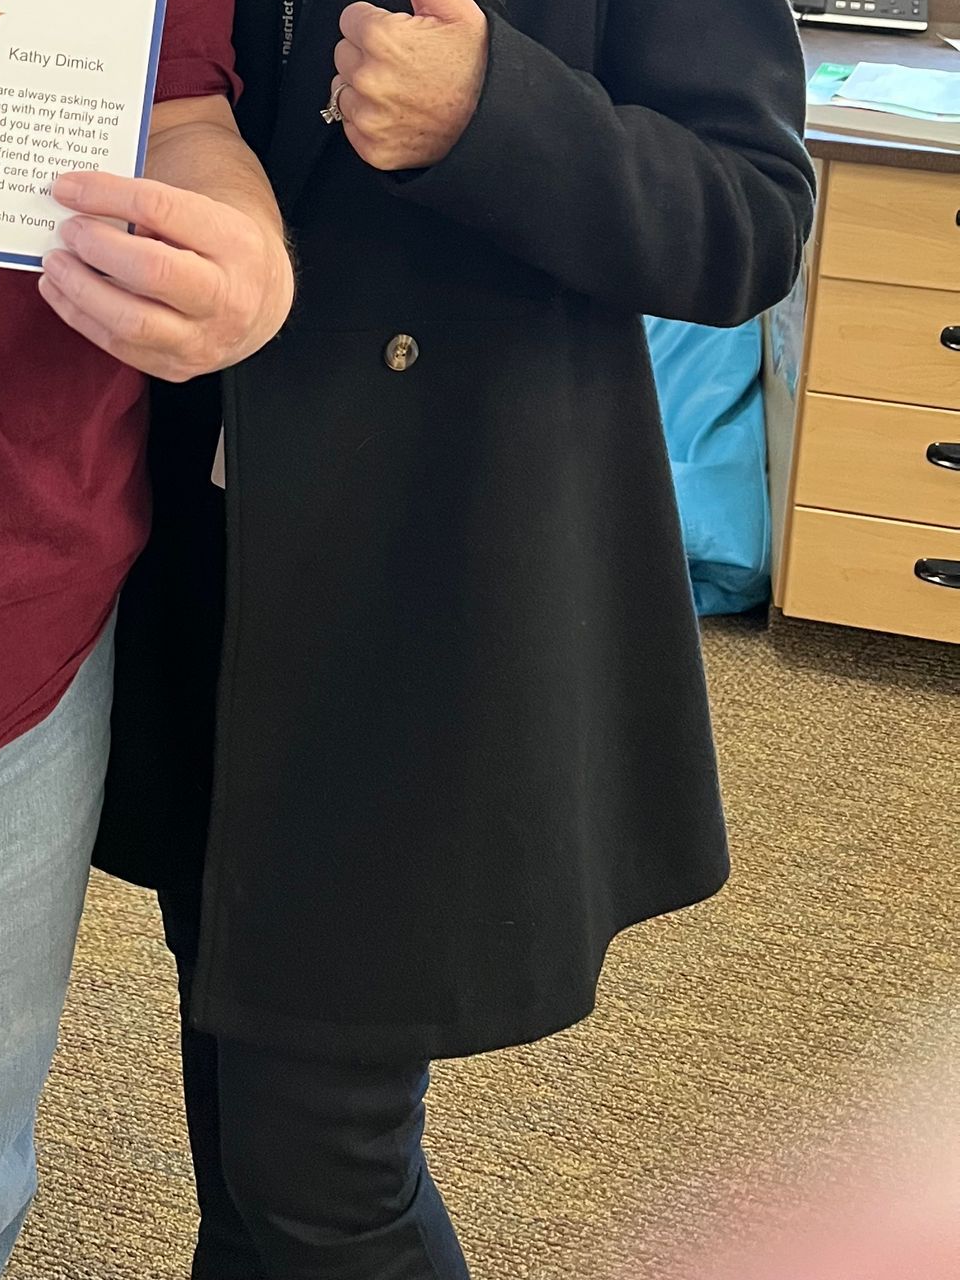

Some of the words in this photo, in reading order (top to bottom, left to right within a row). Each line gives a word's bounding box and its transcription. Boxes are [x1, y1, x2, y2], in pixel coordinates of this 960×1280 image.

[8, 46, 51, 68] Kathy
[55, 53, 104, 72] Dimick
[18, 88, 57, 104] always
[60, 95, 98, 110] asking
[101, 98, 125, 111] how
[11, 104, 36, 115] with
[38, 108, 56, 120] my
[59, 108, 94, 125] family
[97, 116, 119, 126] and
[9, 120, 30, 131] you
[33, 123, 52, 133] are
[54, 124, 65, 135] in
[68, 127, 96, 139] what
[99, 129, 109, 141] is
[16, 135, 29, 145] of
[66, 140, 88, 154] You
[90, 146, 109, 156] are
[33, 153, 45, 164] to
[48, 156, 99, 171] everyone
[3, 166, 28, 177] care
[32, 167, 48, 180] for
[8, 183, 36, 194] work
[39, 186, 52, 196] wi
[19, 214, 56, 231] Young
